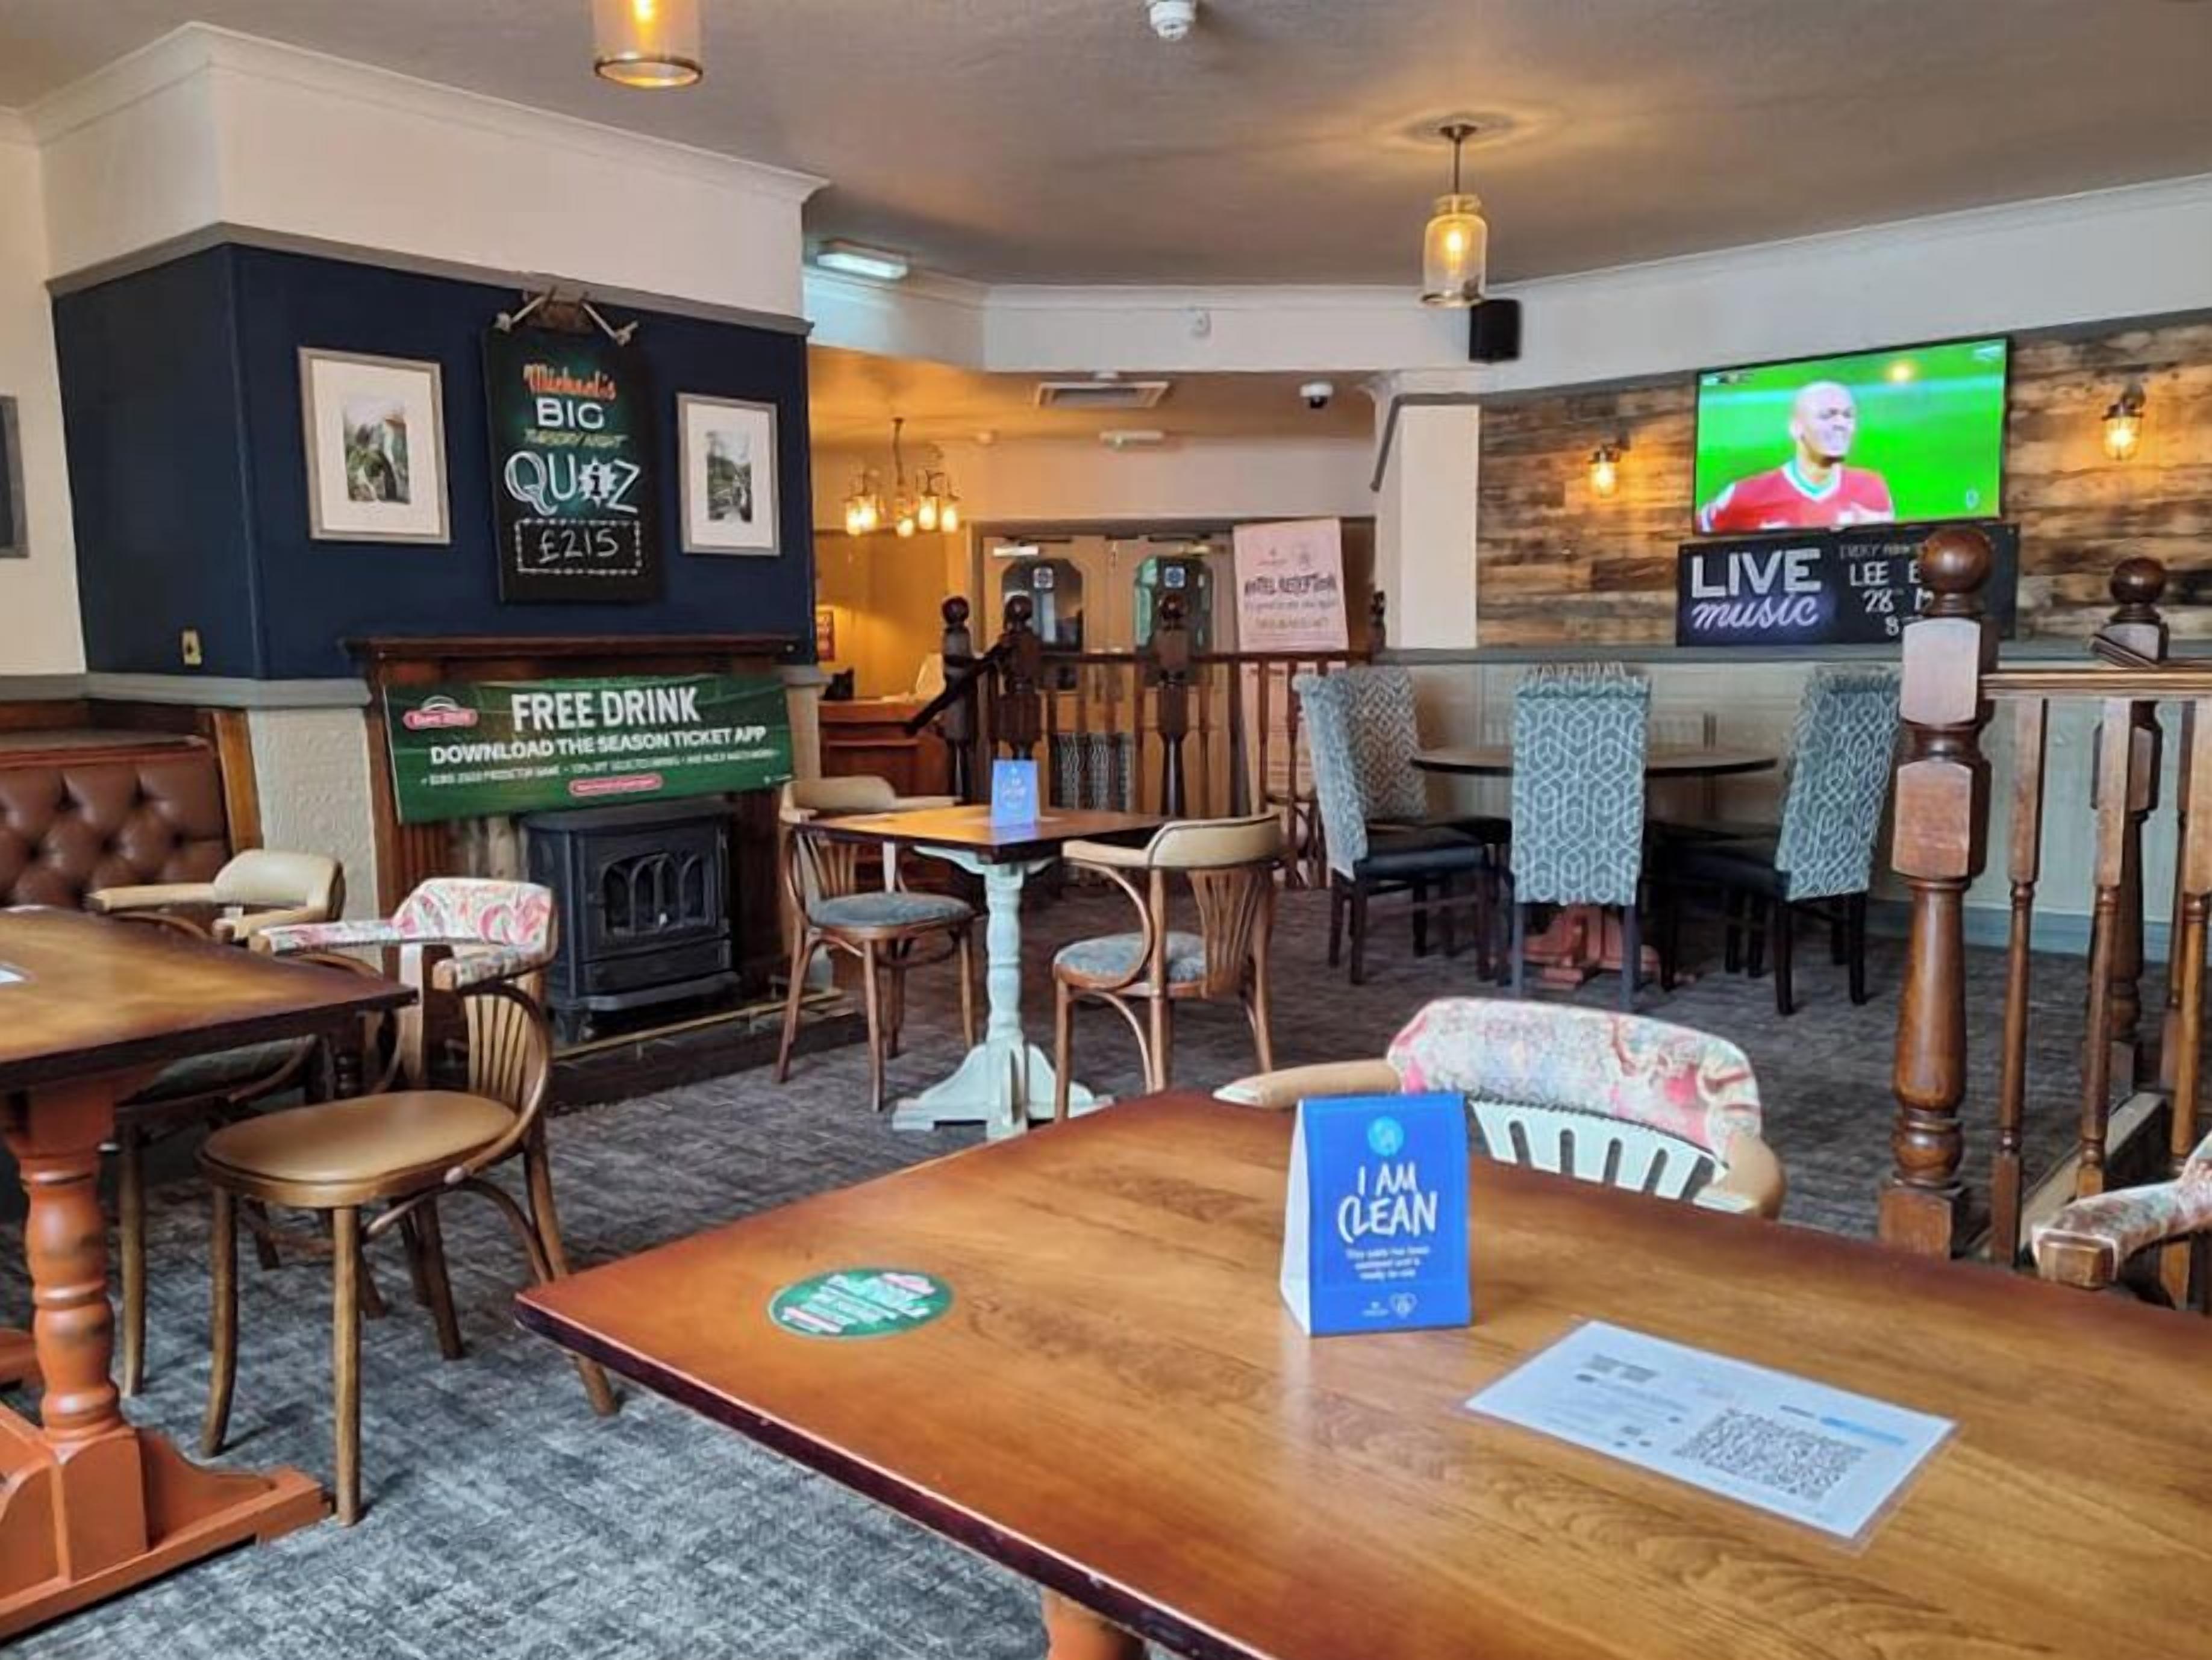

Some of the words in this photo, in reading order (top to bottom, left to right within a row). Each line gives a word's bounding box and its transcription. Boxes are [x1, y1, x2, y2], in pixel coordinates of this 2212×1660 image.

[523, 364, 617, 401] Michael's
[536, 396, 605, 429] BIG
[539, 526, 620, 564] £215
[1691, 547, 1822, 599] LIVE
[1849, 561, 1889, 587] LEE
[1691, 590, 1820, 631] music
[511, 692, 596, 731] FREE
[602, 687, 701, 725] DRINK
[430, 739, 554, 766] DOWNLOAD
[557, 735, 595, 755] THE
[598, 731, 670, 754] SEASON
[670, 727, 731, 748] TICKET
[734, 725, 767, 744] APP
[1358, 1165, 1366, 1196] I
[1376, 1162, 1417, 1196] AM
[1337, 1190, 1439, 1244] CLEAN
